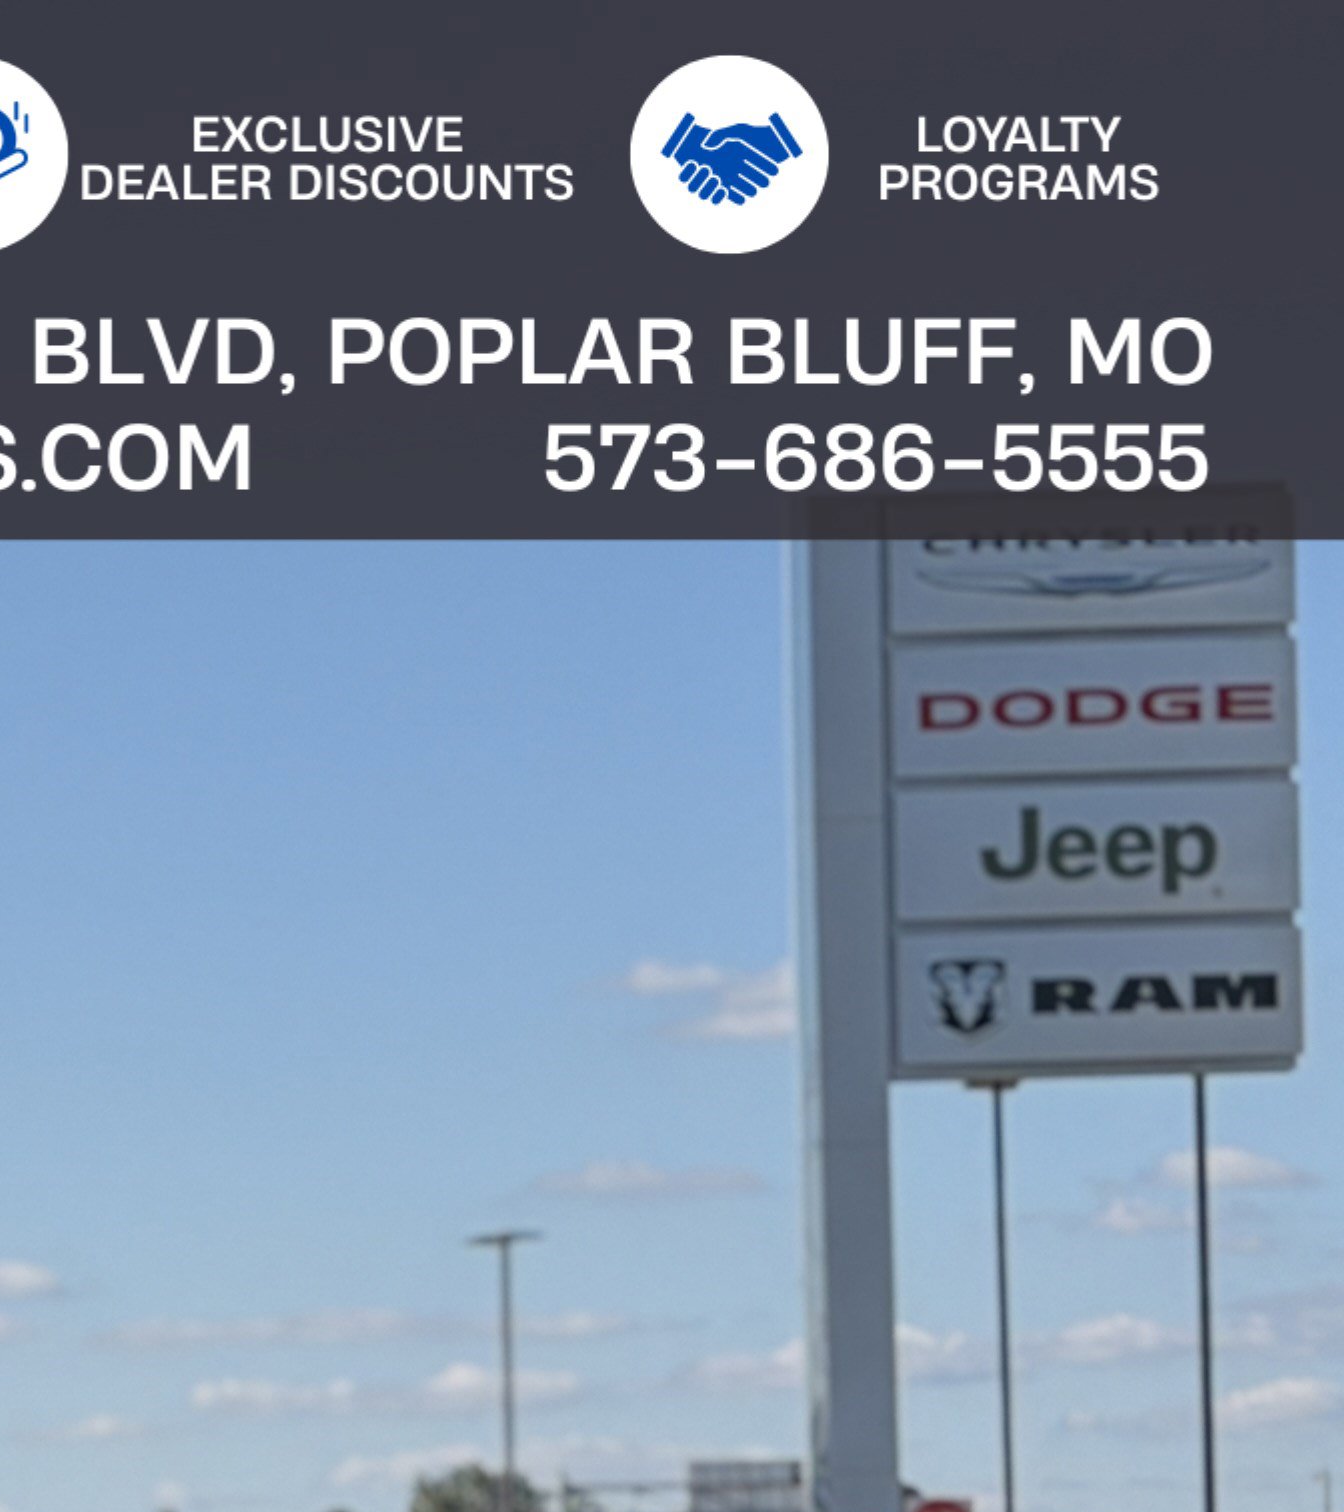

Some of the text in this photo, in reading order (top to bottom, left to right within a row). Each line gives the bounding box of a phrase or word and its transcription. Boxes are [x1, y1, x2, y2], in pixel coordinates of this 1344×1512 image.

[918, 685, 1274, 731] DODGE
[982, 806, 1218, 894] Jeep
[1032, 974, 1278, 1014] RAM
